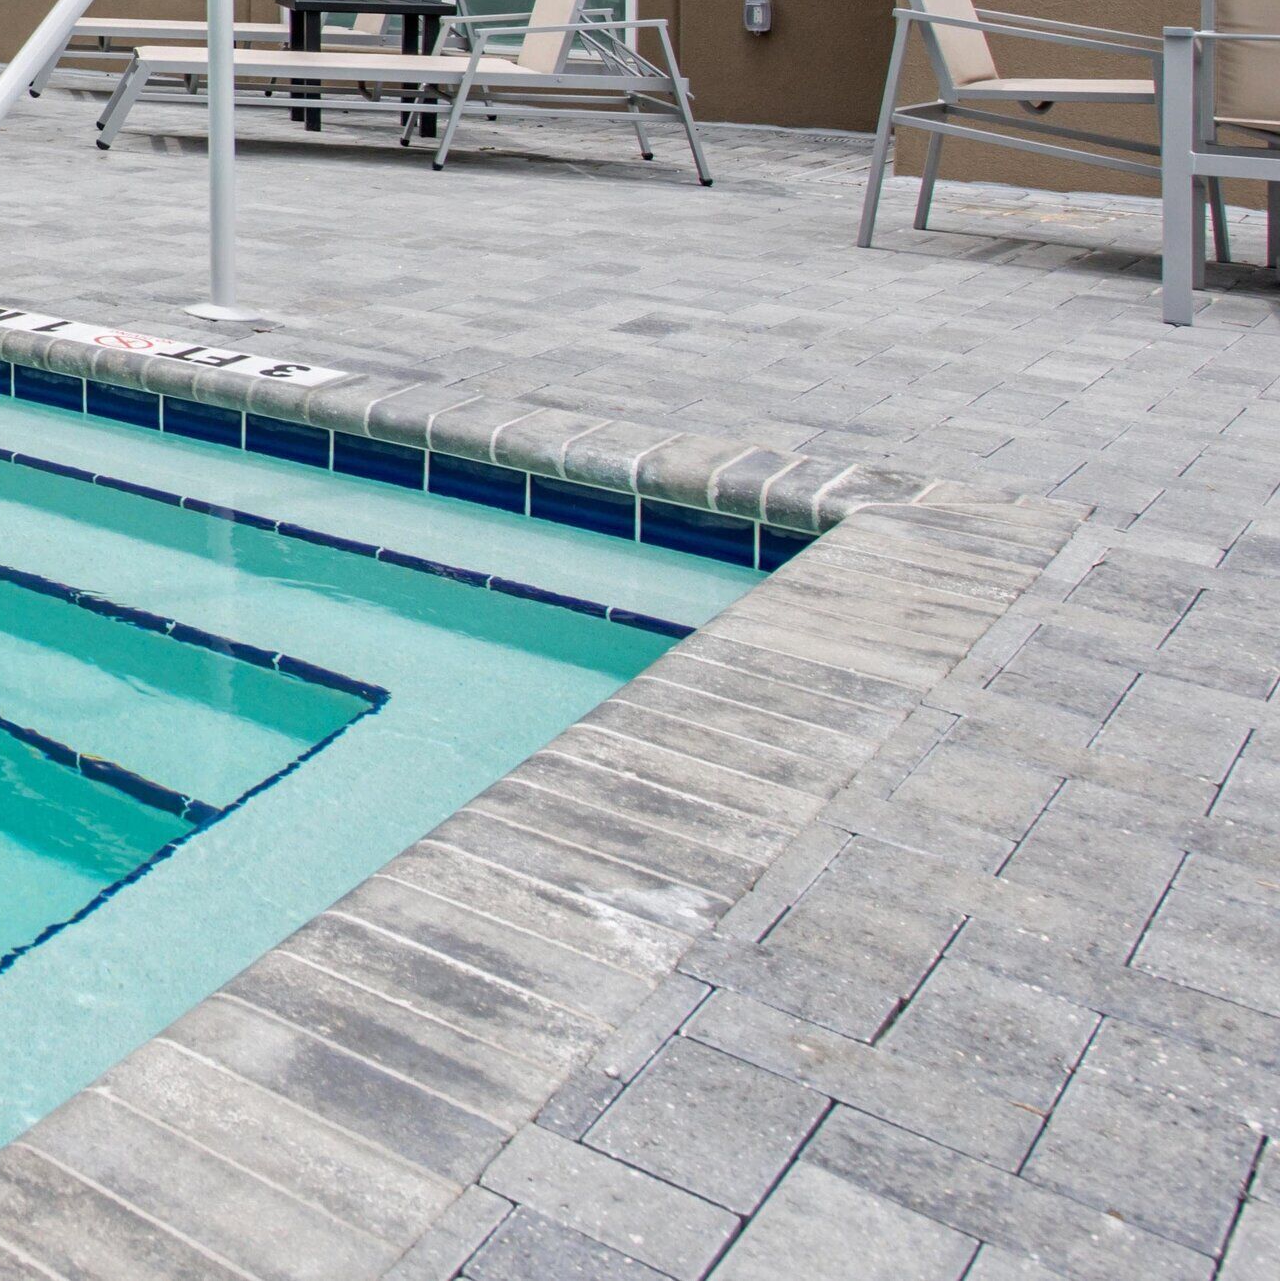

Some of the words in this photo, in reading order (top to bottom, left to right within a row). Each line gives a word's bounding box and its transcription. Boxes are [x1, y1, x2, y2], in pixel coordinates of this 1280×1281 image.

[30, 321, 73, 332] 1
[154, 346, 252, 368] FT
[259, 364, 311, 378] 3
